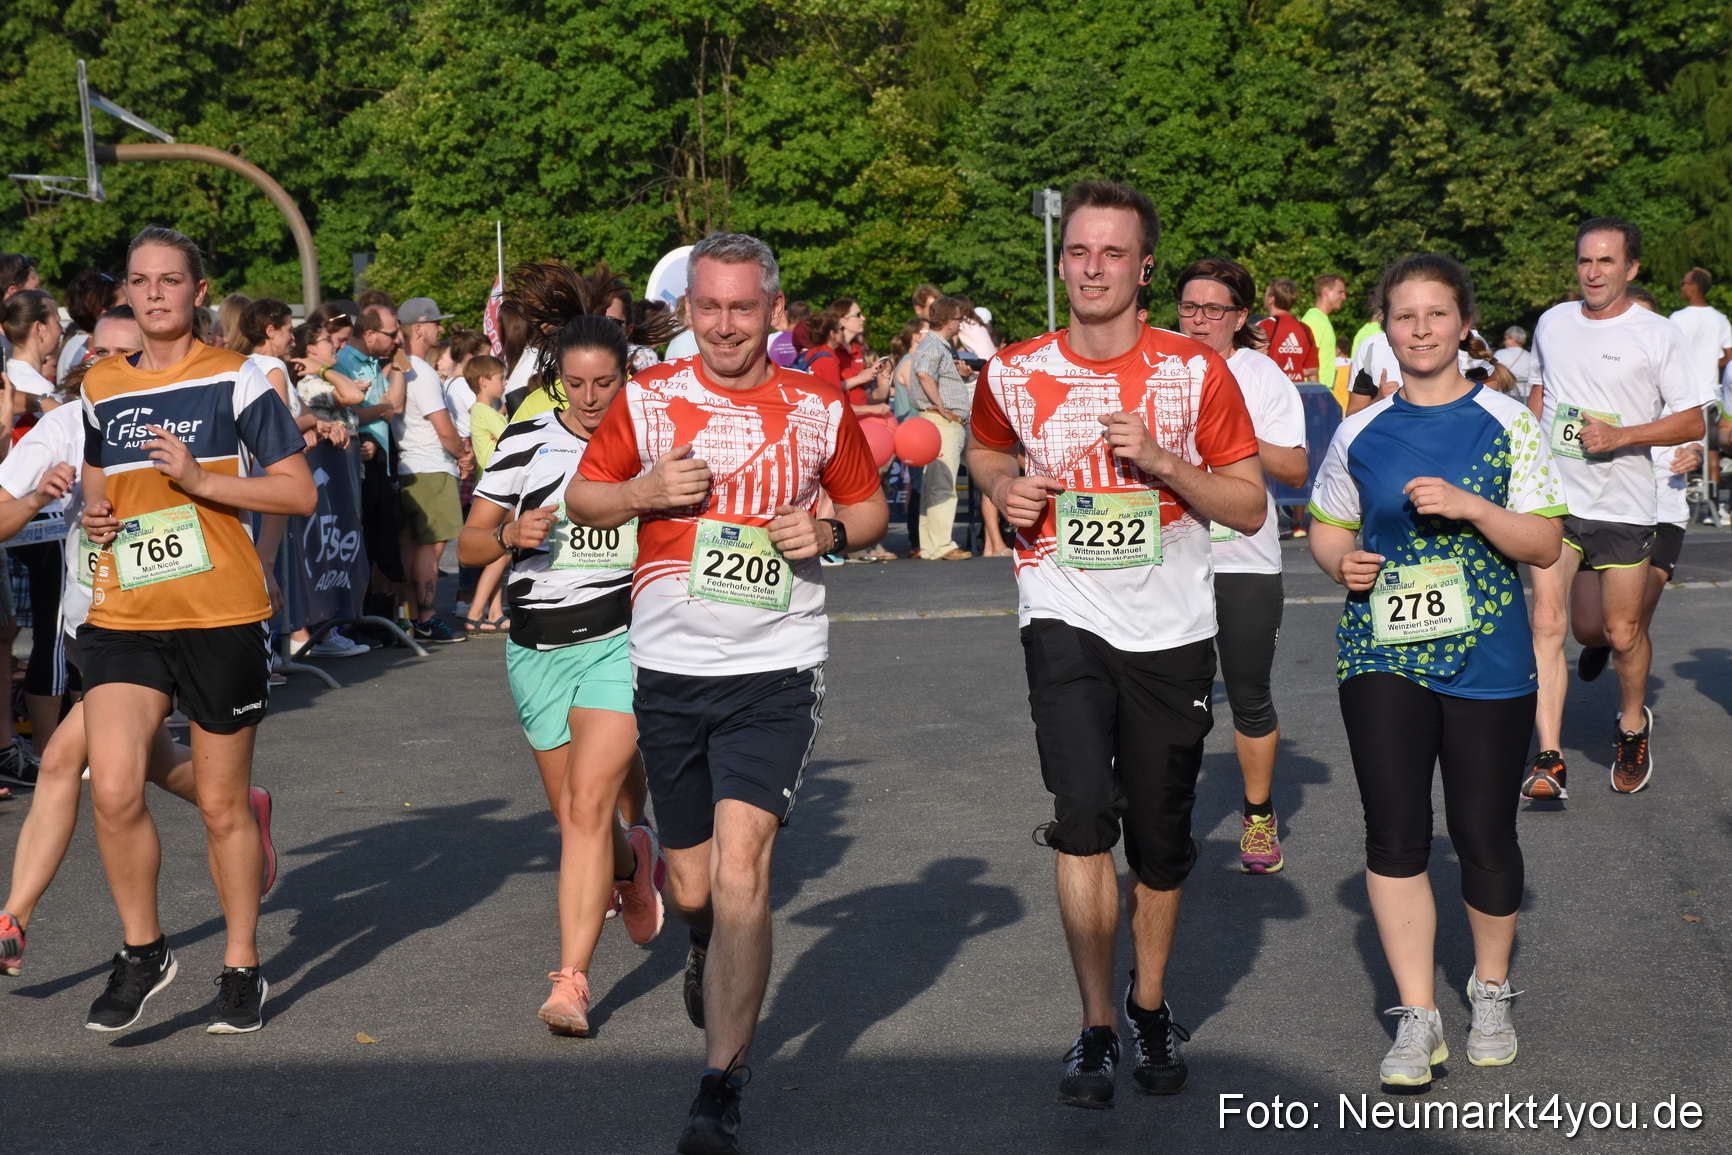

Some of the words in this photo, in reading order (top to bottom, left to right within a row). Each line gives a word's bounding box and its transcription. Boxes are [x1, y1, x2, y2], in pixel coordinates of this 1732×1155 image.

[1602, 353, 1621, 361] Horst
[1064, 413, 1093, 423] 52.01
[1064, 428, 1094, 439] 26.22
[704, 439, 735, 450] 52.01
[1133, 510, 1153, 519] 2019
[176, 522, 194, 532] 2019
[1067, 518, 1146, 547] 2232
[569, 526, 620, 551] 800
[129, 533, 183, 567] 766
[1073, 546, 1111, 556] Wittmann
[1112, 545, 1142, 555] Manuel
[1068, 553, 1095, 562] Sparkasse
[1095, 553, 1148, 562] Neumarkt-Parsberg
[132, 573, 149, 581] Fischer
[149, 567, 177, 578] Automobile
[177, 563, 193, 572] GmbH
[141, 564, 156, 573] Mall
[157, 559, 180, 570] Nicole
[702, 549, 781, 587] 2208
[706, 578, 751, 592] Federhofer
[752, 584, 775, 595] Stefan
[1440, 578, 1459, 588] 2019
[700, 585, 729, 596] Sparkasse
[729, 589, 779, 603] Neumarkt-Parsberg
[1387, 589, 1446, 623] 278
[1387, 621, 1422, 631] Weinzierl
[1423, 616, 1453, 627] Shelley
[1403, 627, 1429, 636] Bionorica
[232, 699, 262, 716] hummel
